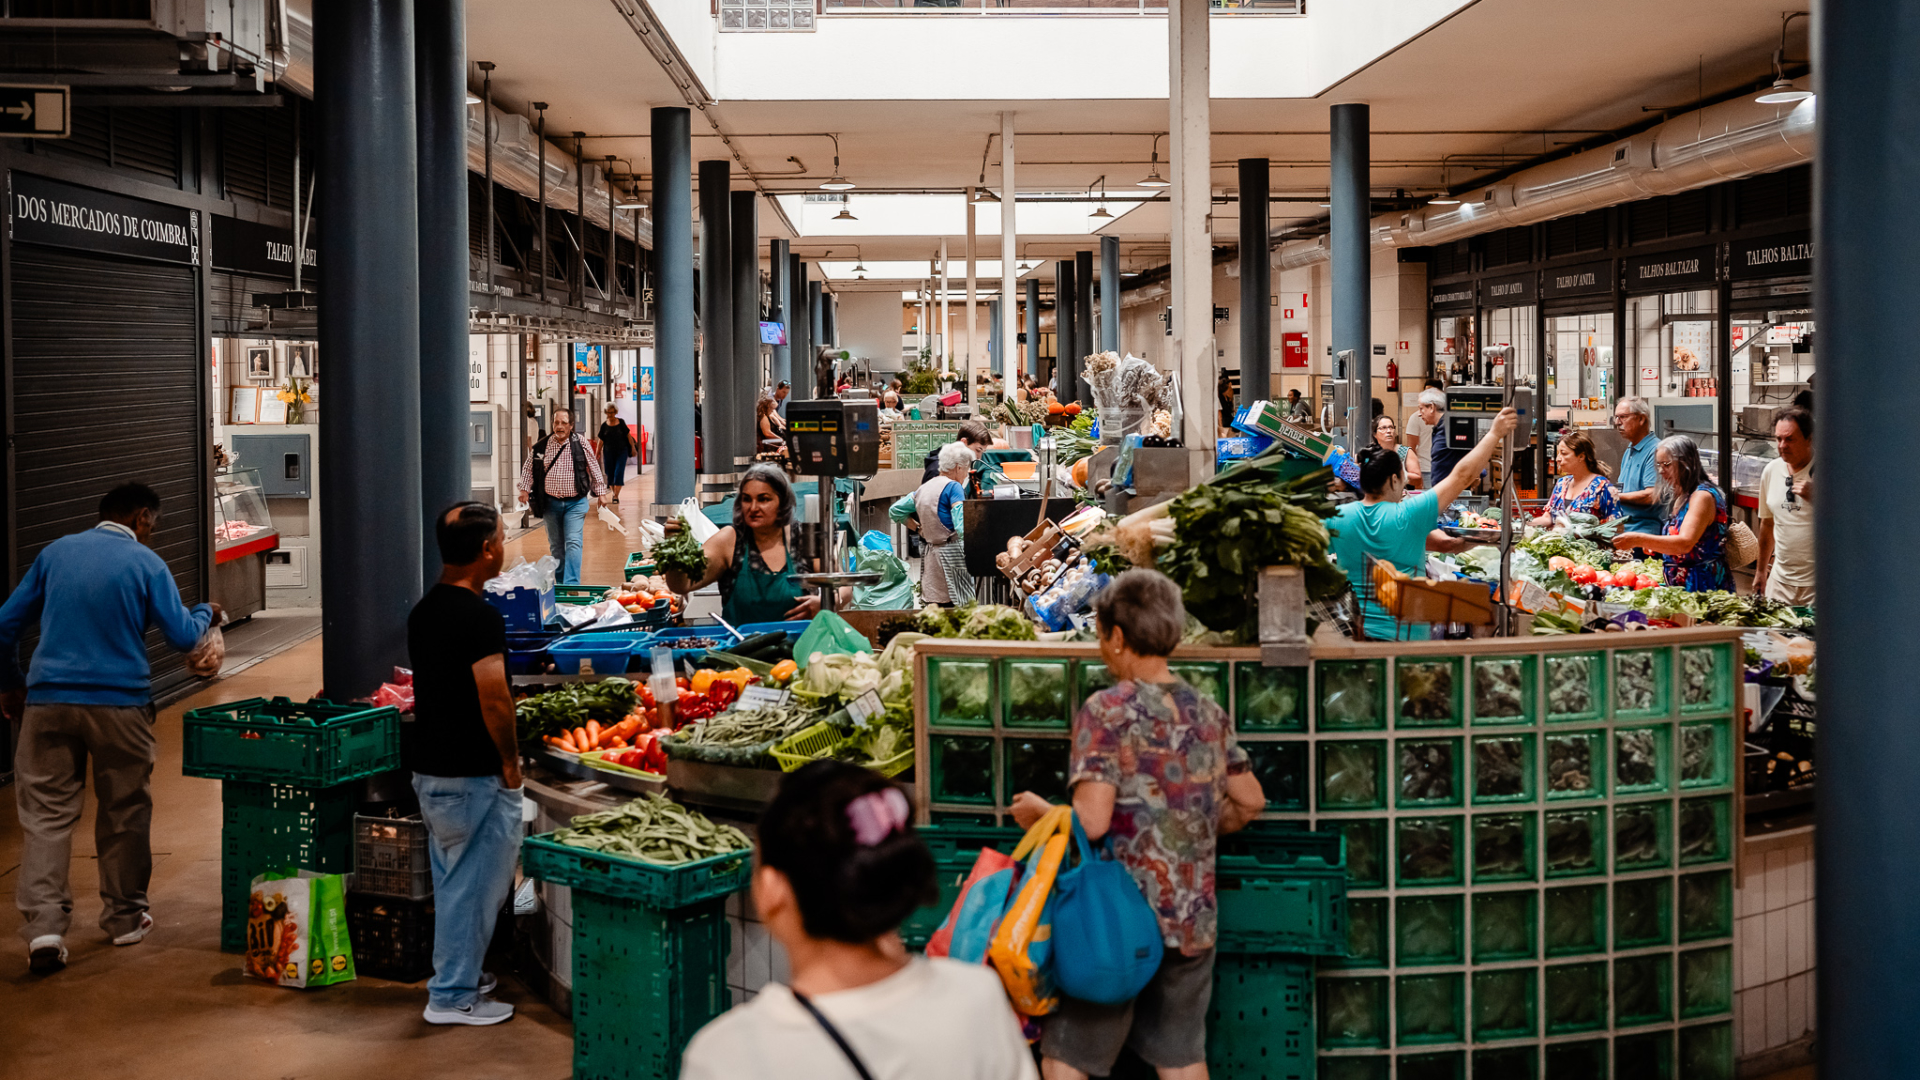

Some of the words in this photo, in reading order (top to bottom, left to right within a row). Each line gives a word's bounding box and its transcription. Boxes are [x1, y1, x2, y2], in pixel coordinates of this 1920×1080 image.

[17, 194, 47, 223] DOS
[51, 203, 120, 236] MERCADOS
[123, 215, 139, 239] DE
[141, 220, 189, 247] COIMBRA
[266, 241, 294, 263] TALHO
[1746, 247, 1779, 266] TALHOS
[1780, 242, 1816, 262] BALTAZ
[1639, 264, 1664, 279] TALHOS
[1665, 258, 1699, 276] BALTAZAR
[1556, 275, 1573, 289] TALHO
[469, 360, 482, 374] do
